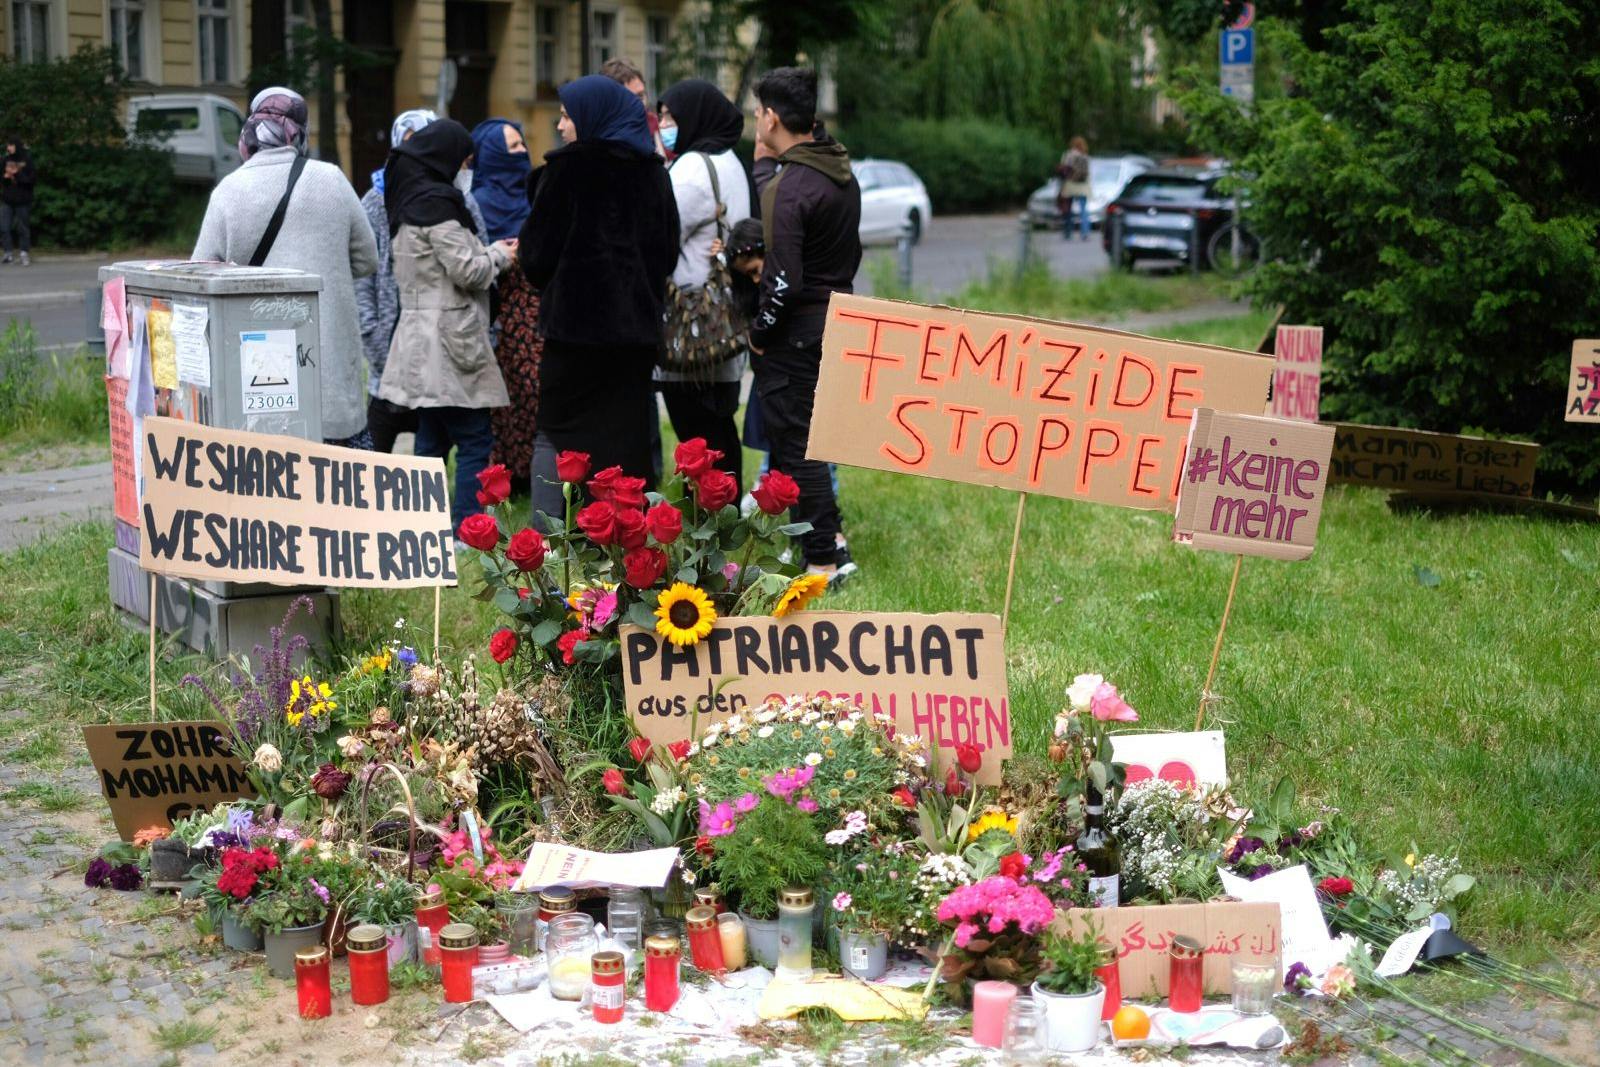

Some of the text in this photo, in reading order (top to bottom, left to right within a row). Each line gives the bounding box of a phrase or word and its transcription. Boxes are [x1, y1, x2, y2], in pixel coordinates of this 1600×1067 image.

[1227, 33, 1247, 61] P
[247, 395, 293, 410] 23004
[880, 396, 1187, 503] STOPPE
[1188, 436, 1320, 499] #keine
[1455, 442, 1526, 468] tötet
[147, 432, 204, 489] WE
[205, 440, 302, 501] SHARE
[308, 455, 369, 509] THE
[373, 465, 447, 513] PAIN
[1412, 468, 1450, 482] aus
[1455, 466, 1531, 494] Liebe
[1209, 493, 1309, 541] mehr
[143, 502, 457, 581] WE SHARE THE RAGE
[626, 621, 984, 684] PATRIARCHAT
[638, 693, 686, 717] aus
[697, 678, 747, 715] den
[911, 691, 1009, 753] HEBEN
[116, 725, 240, 761] ZOHR
[102, 763, 259, 799] MOHAMM
[556, 852, 578, 880] NEIN
